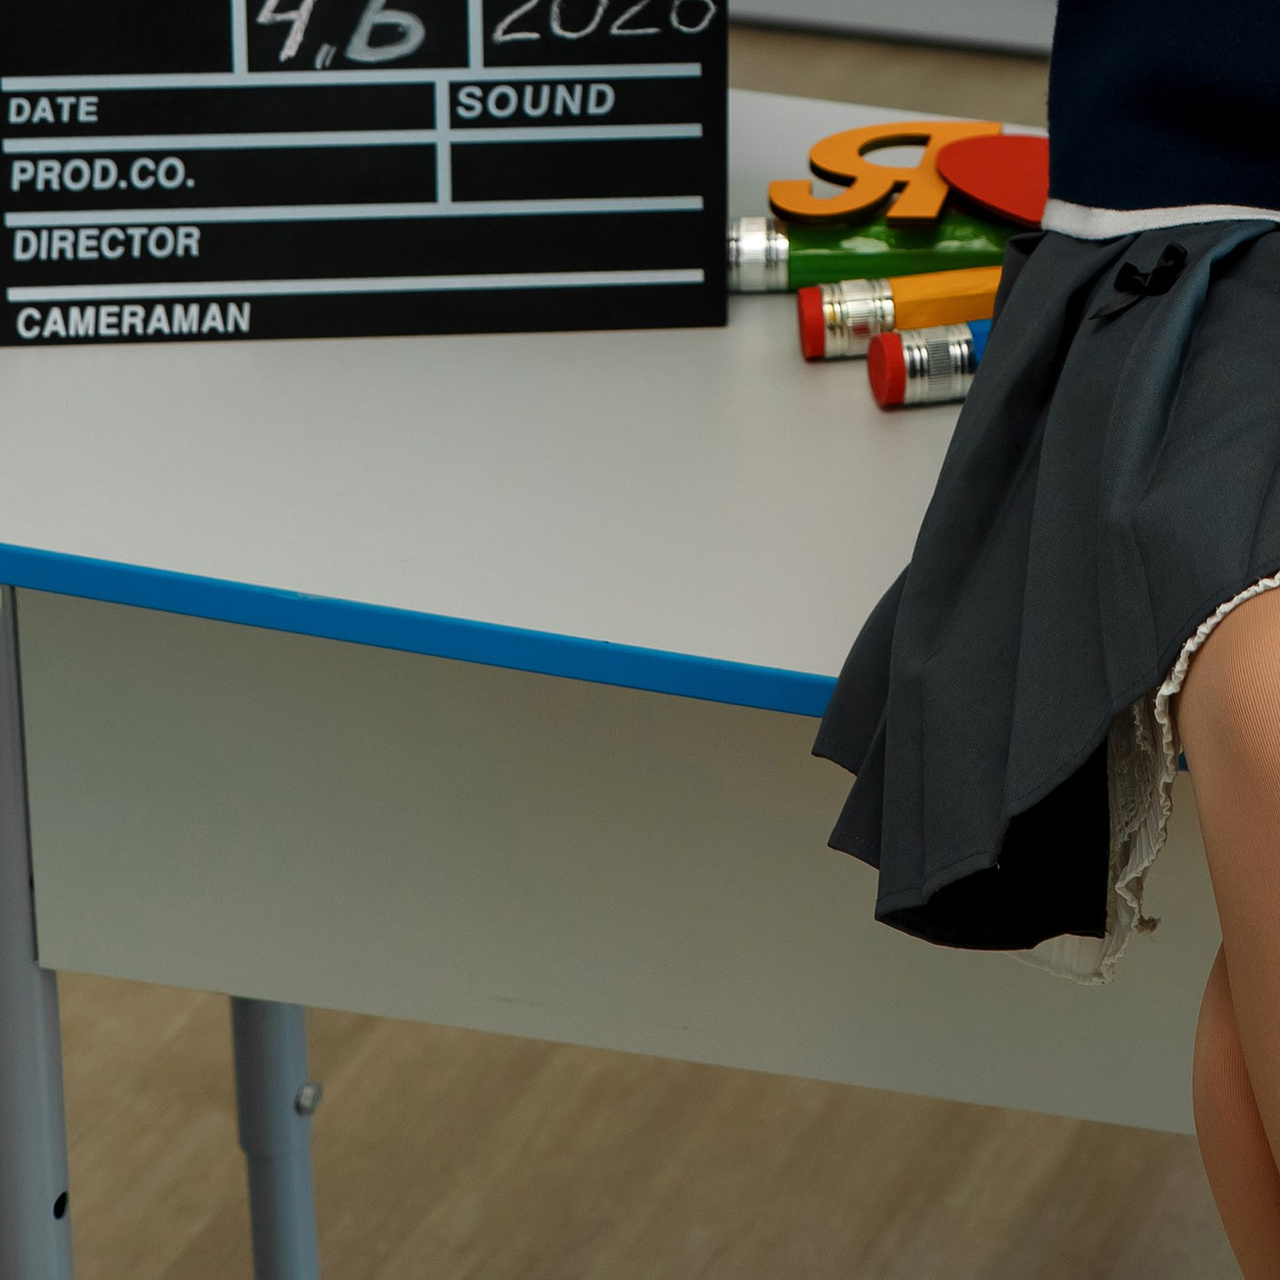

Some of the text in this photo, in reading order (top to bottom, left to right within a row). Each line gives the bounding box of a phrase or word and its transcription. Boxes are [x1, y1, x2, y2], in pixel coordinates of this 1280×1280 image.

[8, 95, 99, 124] DATE
[456, 84, 616, 119] SOUND
[10, 156, 195, 192] PROD.CO.
[13, 225, 201, 262] DIRECTOR
[16, 301, 251, 339] CAMERAMAN
